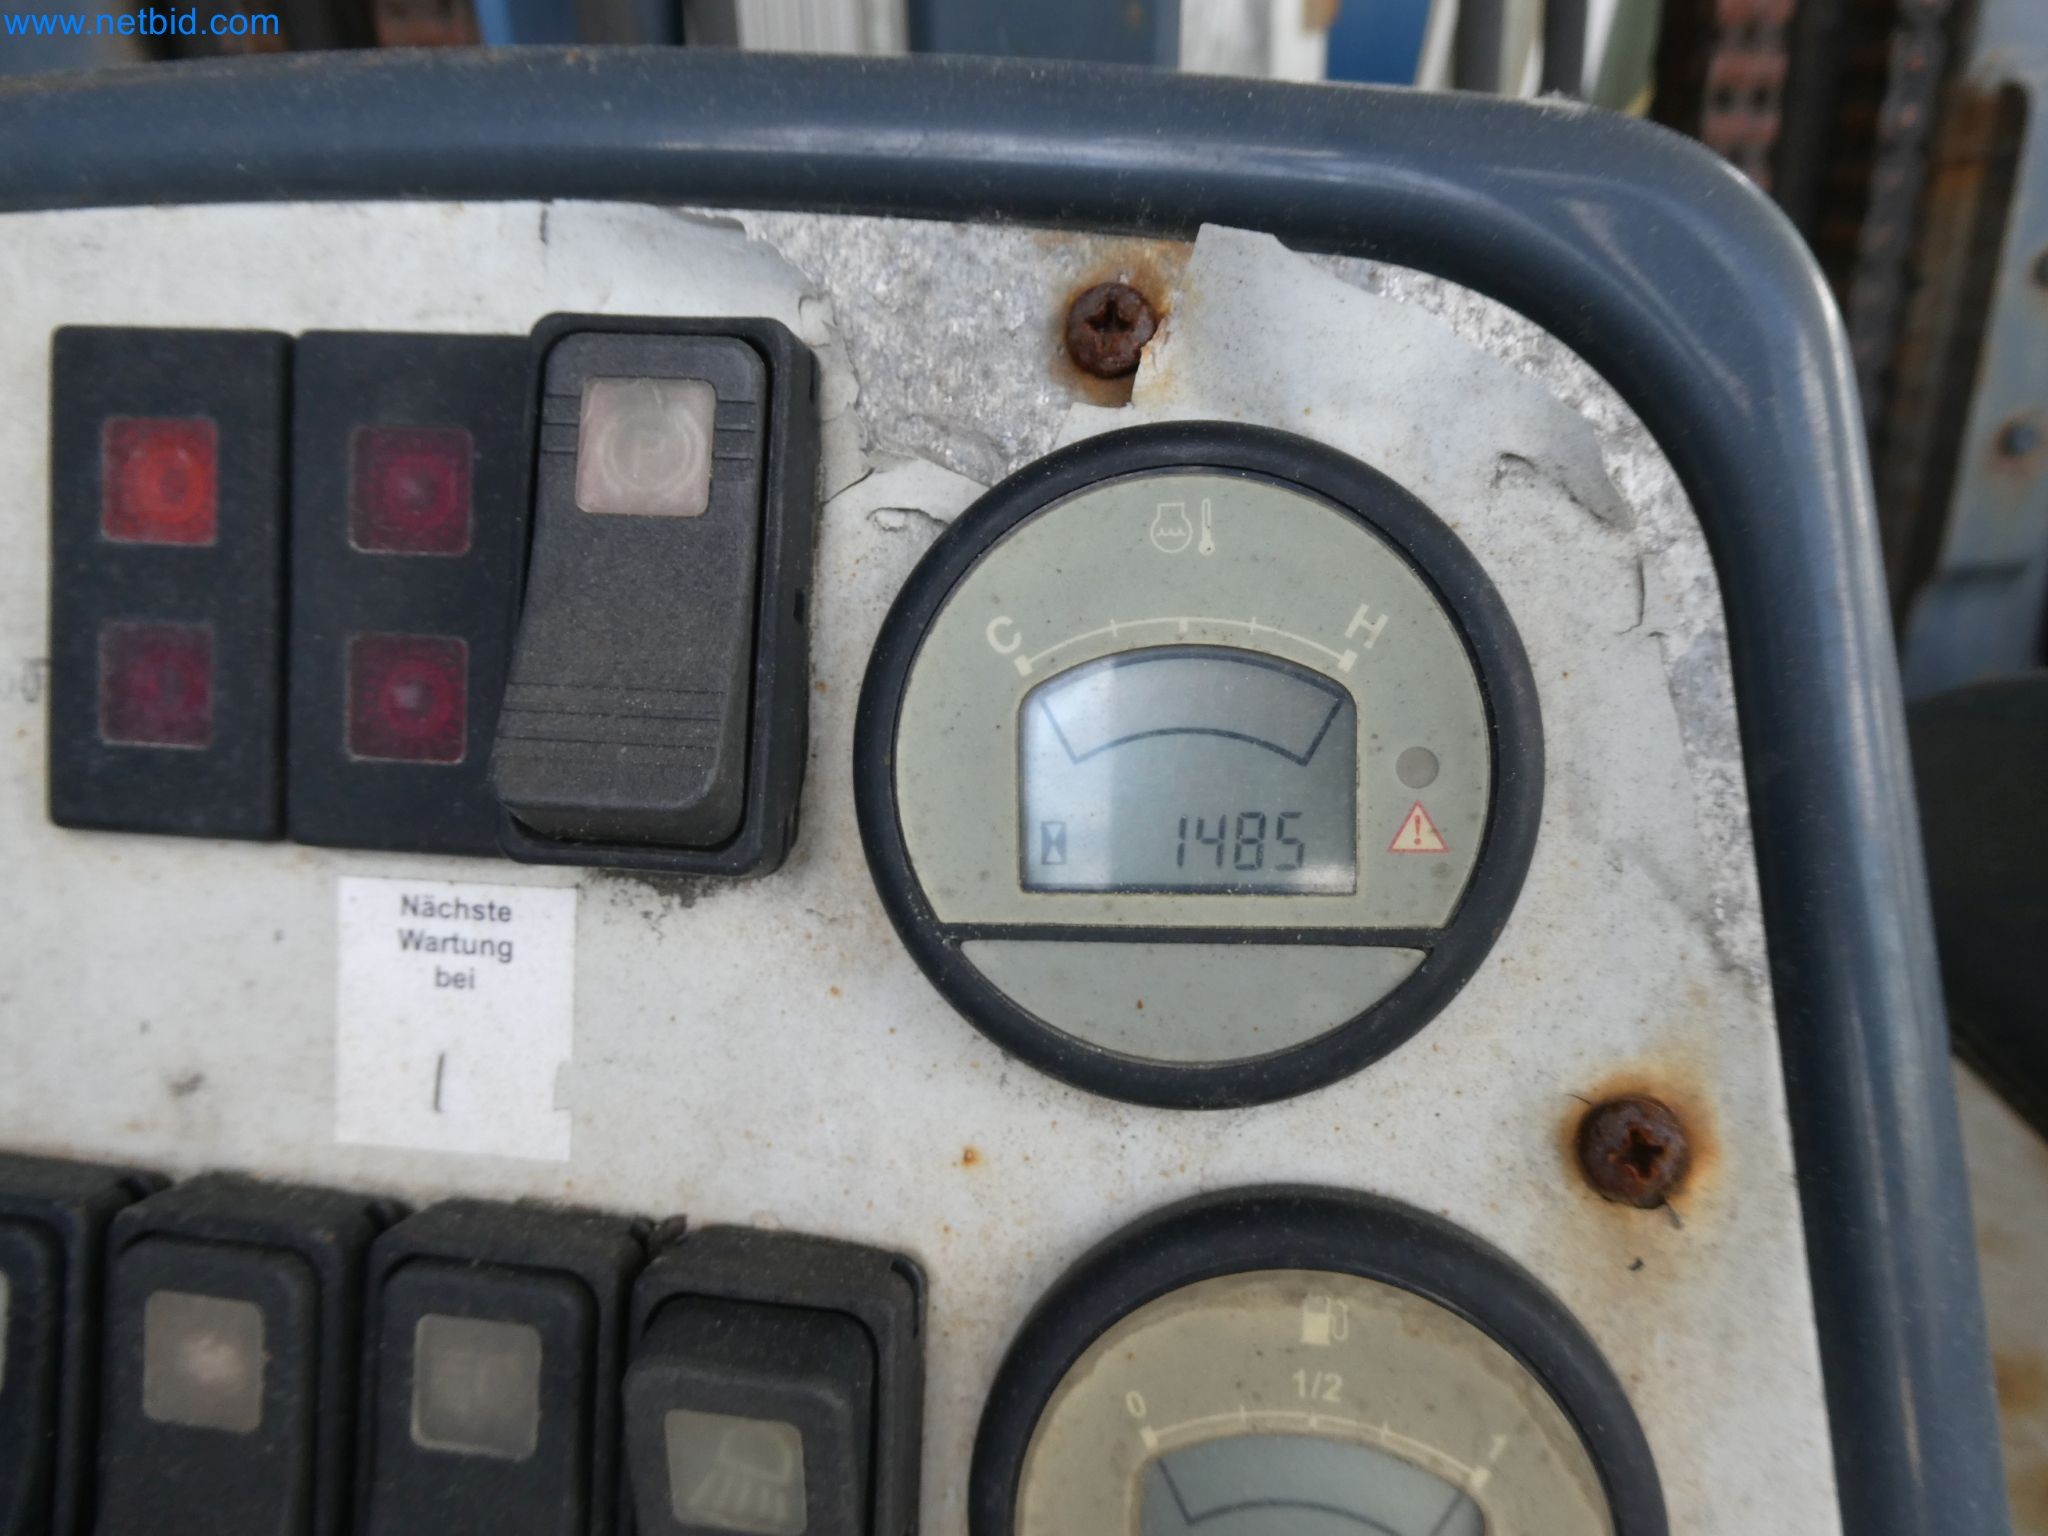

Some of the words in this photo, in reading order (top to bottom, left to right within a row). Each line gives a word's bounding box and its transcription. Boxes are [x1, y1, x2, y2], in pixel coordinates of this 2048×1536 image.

[986, 616, 1022, 654] C
[1345, 604, 1389, 649] H
[1176, 811, 1306, 871] 1485
[401, 895, 513, 923] Nächste
[399, 929, 514, 964] Wartung
[434, 966, 476, 990] bei
[1293, 1369, 1343, 1402] 1/2
